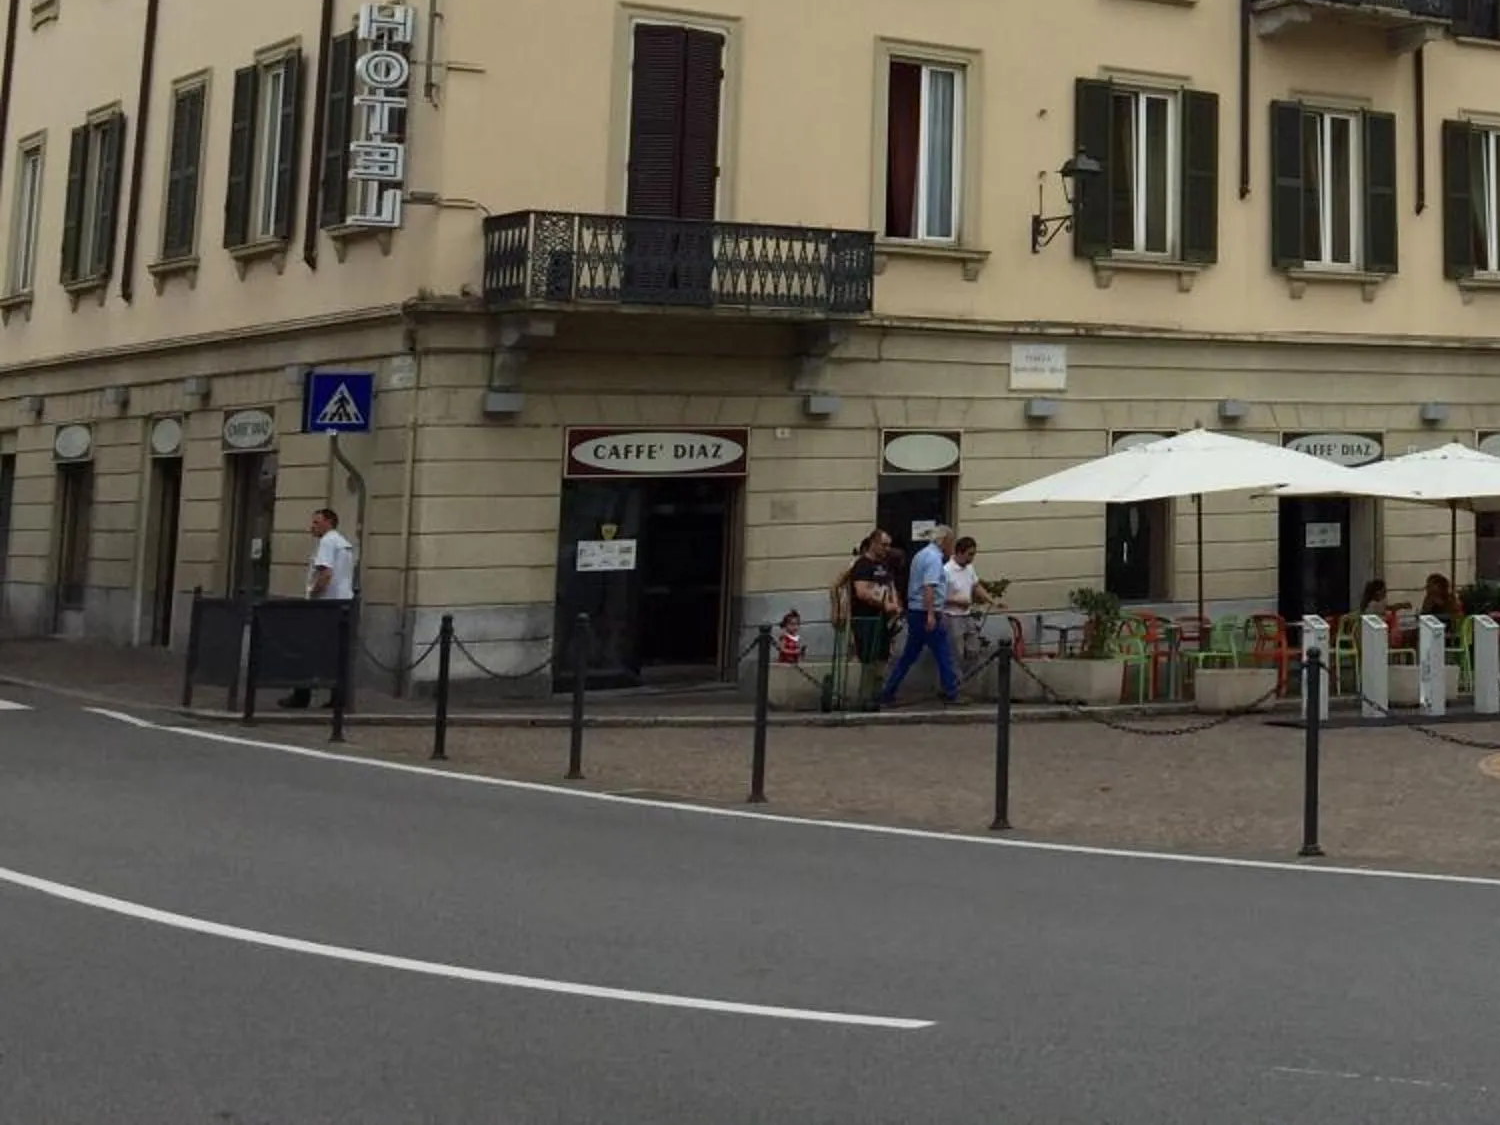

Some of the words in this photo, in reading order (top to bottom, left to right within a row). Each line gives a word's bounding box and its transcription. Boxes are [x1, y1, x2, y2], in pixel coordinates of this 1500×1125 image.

[346, 3, 416, 228] HOTEL
[593, 443, 664, 460] CAFFE'
[673, 443, 724, 460] DIAZ
[1341, 443, 1372, 456] DIAZ
